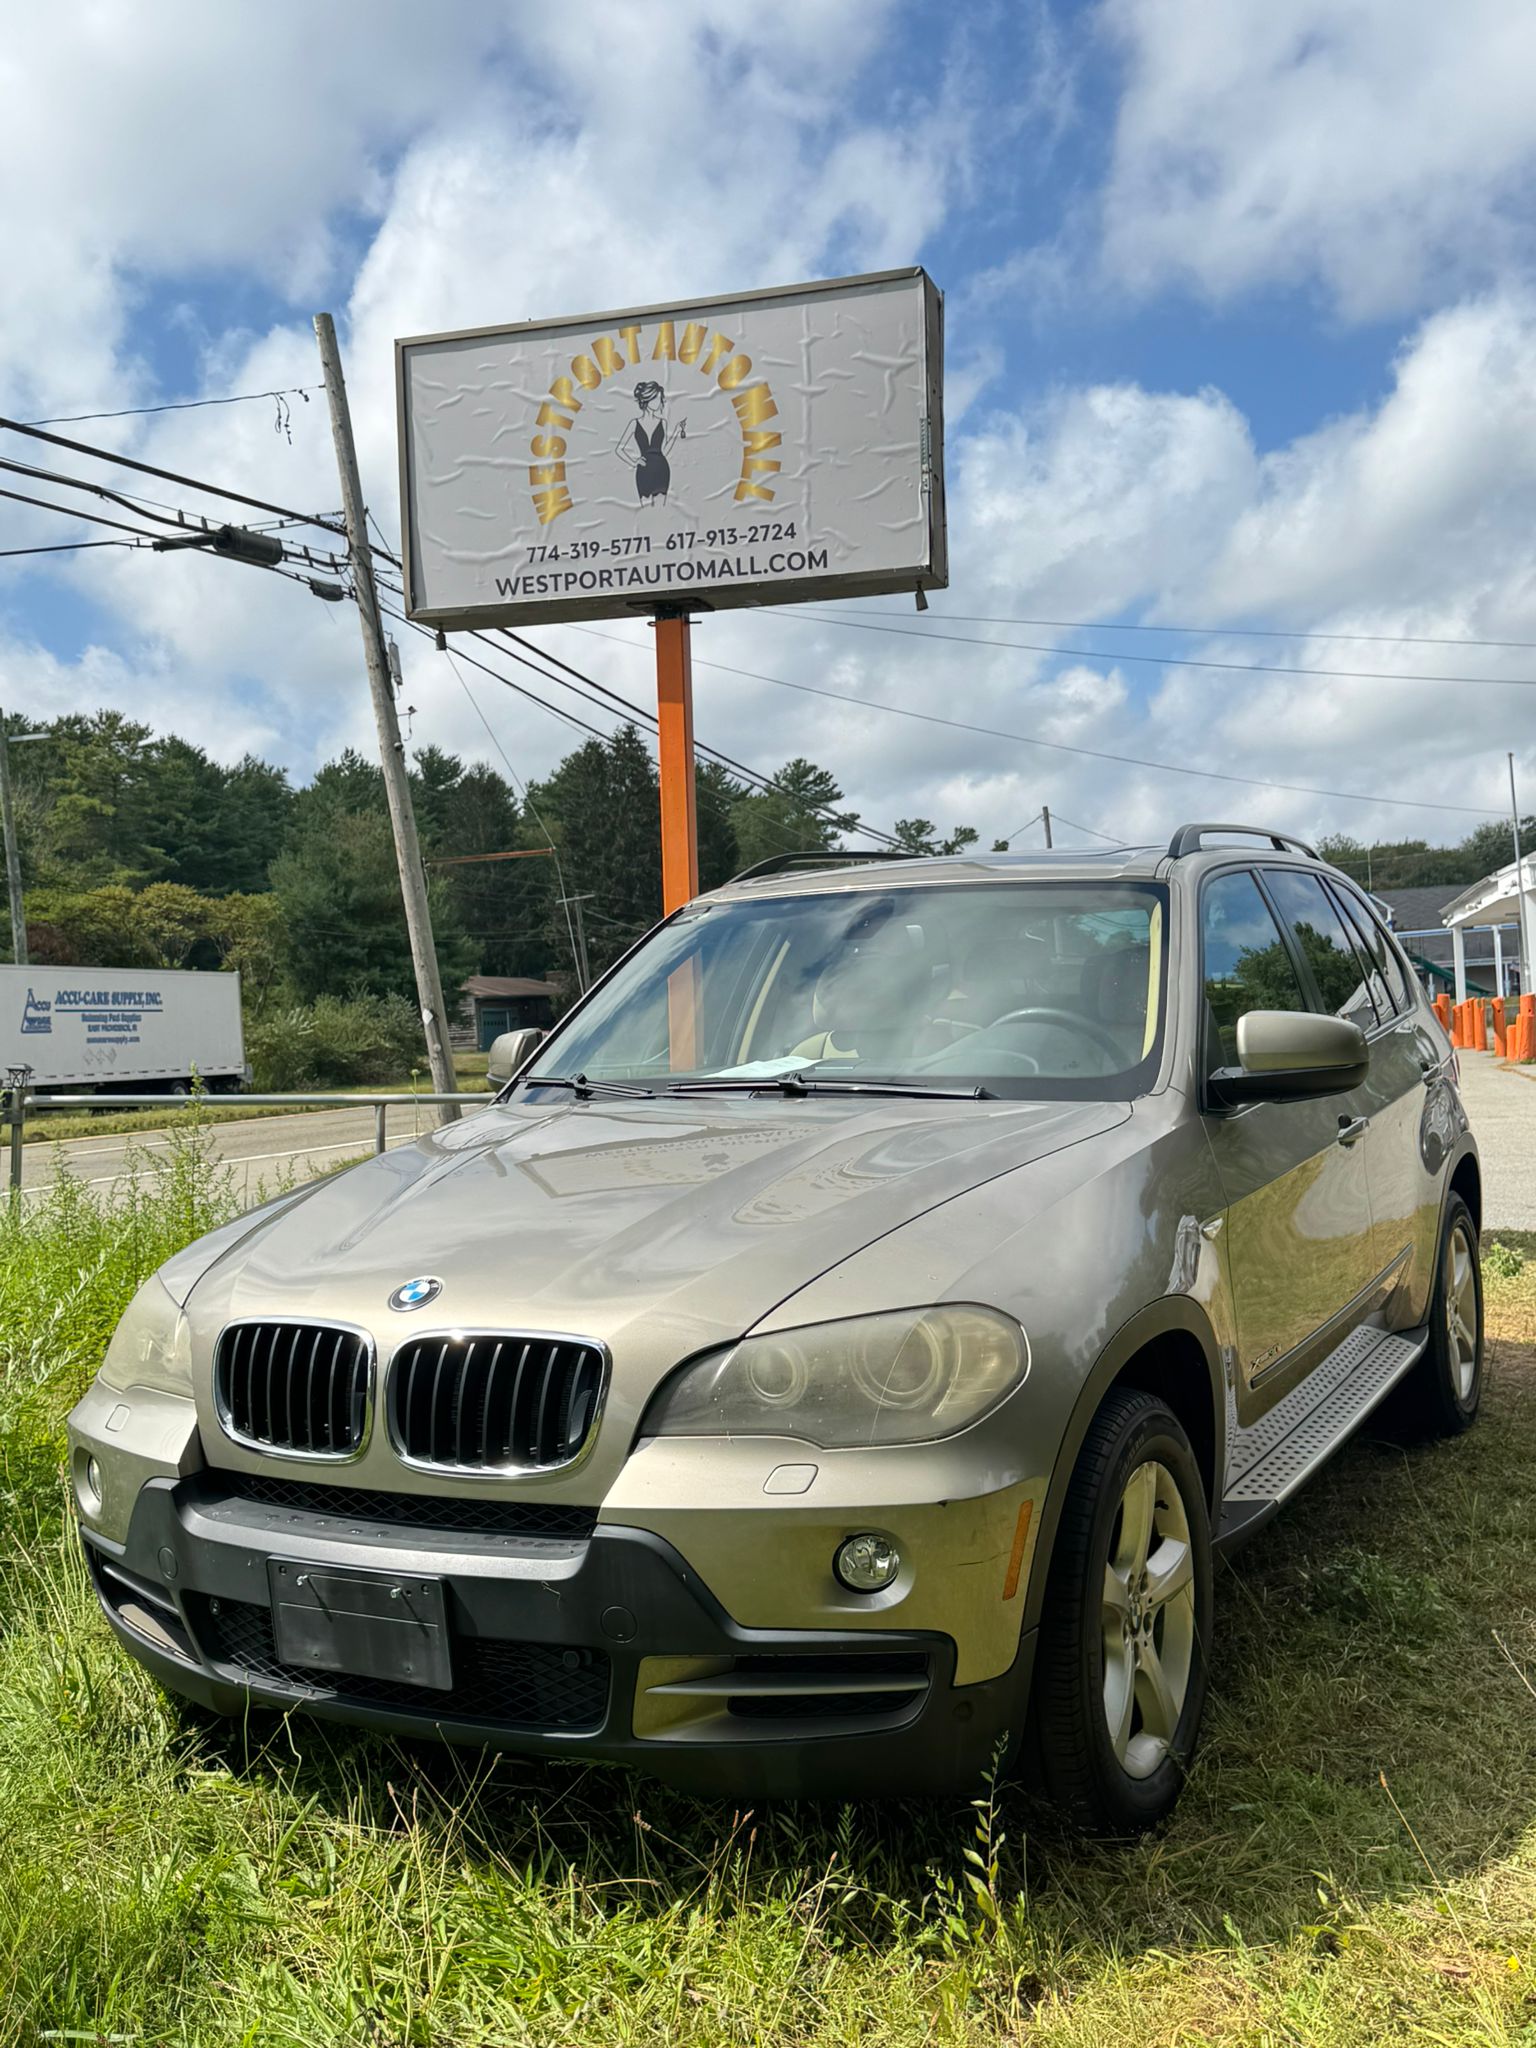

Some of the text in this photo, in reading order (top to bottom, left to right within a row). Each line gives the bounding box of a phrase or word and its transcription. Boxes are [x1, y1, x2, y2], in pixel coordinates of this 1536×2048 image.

[529, 323, 643, 526] WESTPORT
[526, 522, 797, 563] 774-319-5771 617-913-2724
[495, 549, 829, 597] WESTPORTAUTOMALL.COM
[55, 991, 110, 1005] ACCU-CARE
